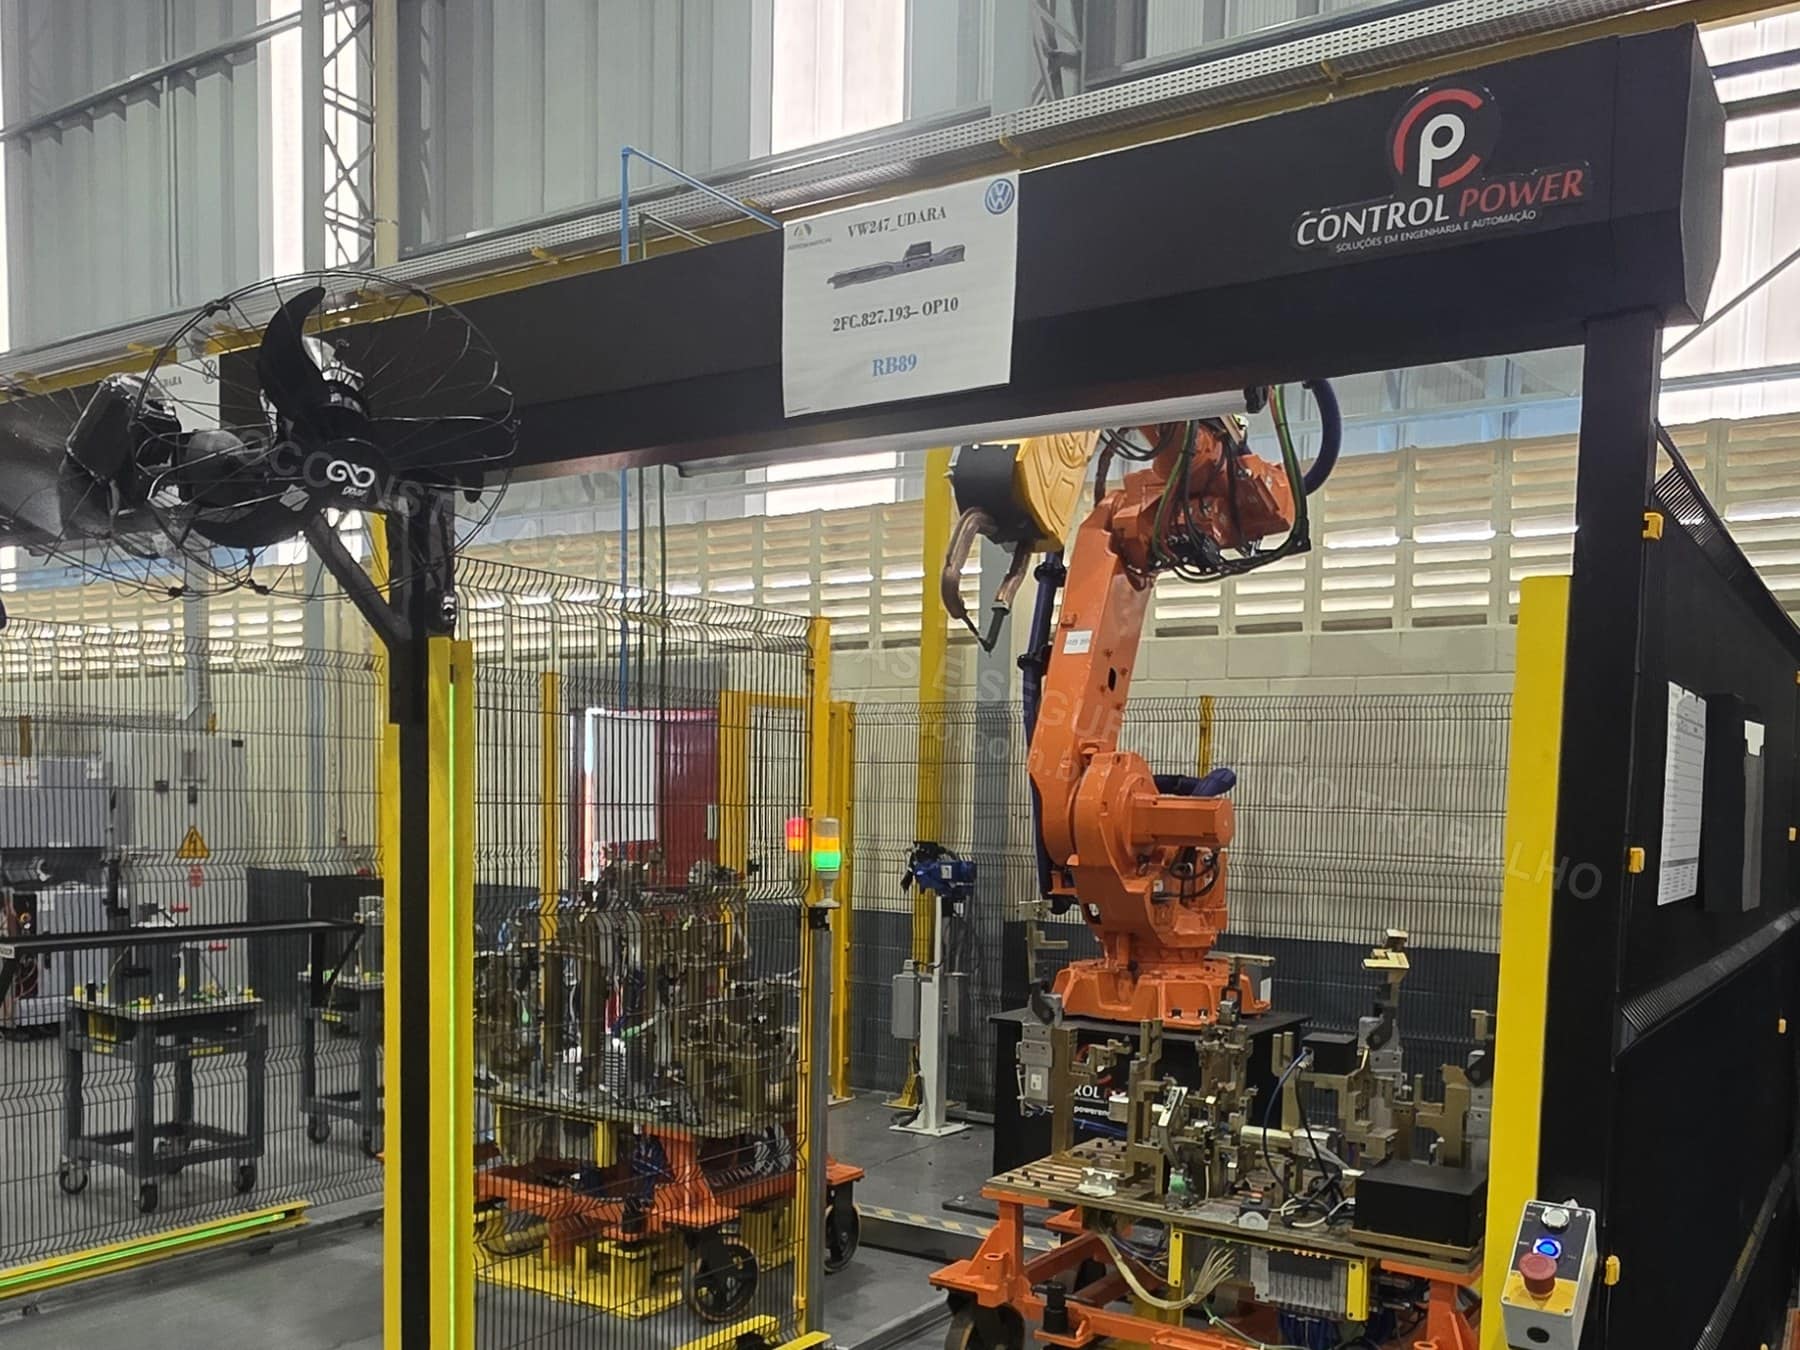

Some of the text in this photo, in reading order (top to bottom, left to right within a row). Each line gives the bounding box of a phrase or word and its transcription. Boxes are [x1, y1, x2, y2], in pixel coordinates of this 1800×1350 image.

[847, 206, 948, 239] VW247_UDARA
[1296, 168, 1584, 246] CONTROL POWER
[1336, 236, 1382, 253] SOLUÇÕES
[1384, 233, 1399, 244] EM
[1400, 222, 1462, 242] ENGENHARIA
[1472, 209, 1537, 228] AUTOMAÇÃO
[921, 296, 959, 317] OP10
[871, 353, 917, 378] RB89
